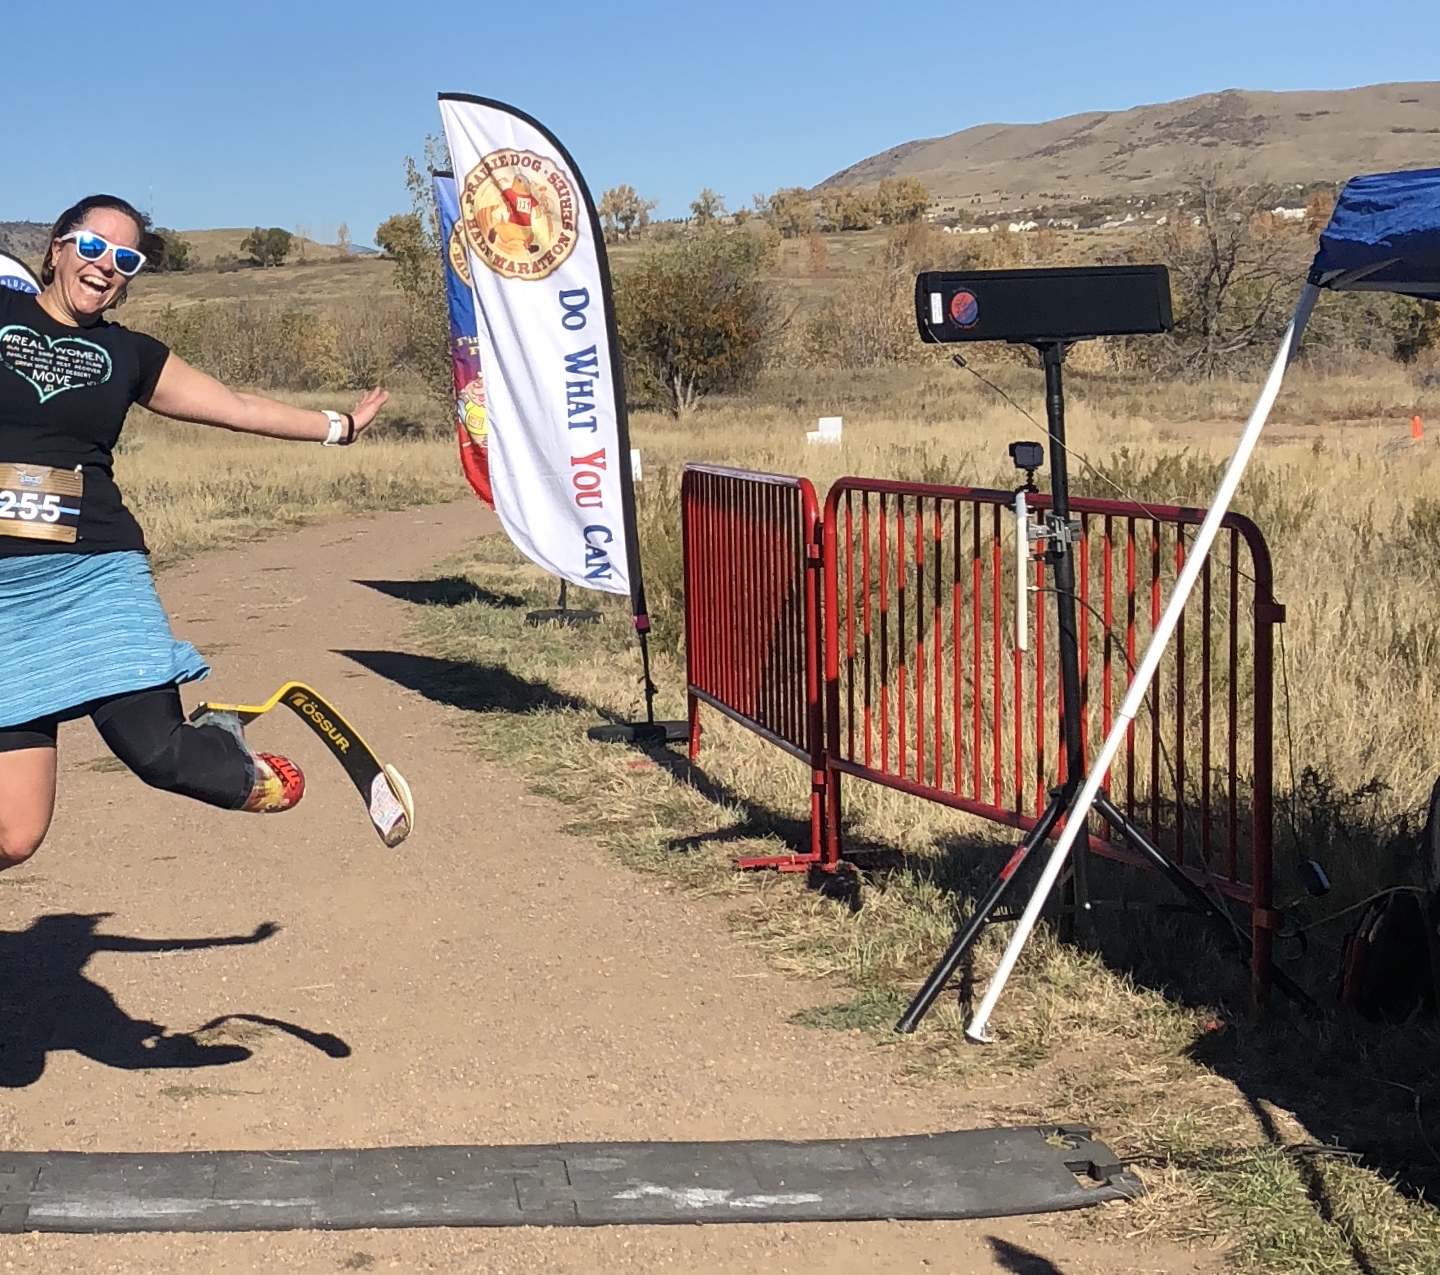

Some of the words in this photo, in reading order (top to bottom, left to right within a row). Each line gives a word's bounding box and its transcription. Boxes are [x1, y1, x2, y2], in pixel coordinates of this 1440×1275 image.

[510, 153, 542, 172] DOG
[547, 171, 574, 232] SERIES
[466, 217, 494, 258] HALF
[492, 231, 572, 275] MARATHON
[558, 286, 590, 331] DO
[2, 333, 45, 351] #REAL
[54, 346, 104, 364] WOMEN
[32, 369, 72, 387] MOVE
[563, 344, 600, 433] WHAT
[570, 447, 607, 509] YOU
[582, 524, 613, 580] CAN
[302, 702, 351, 753] ÖSSUR
